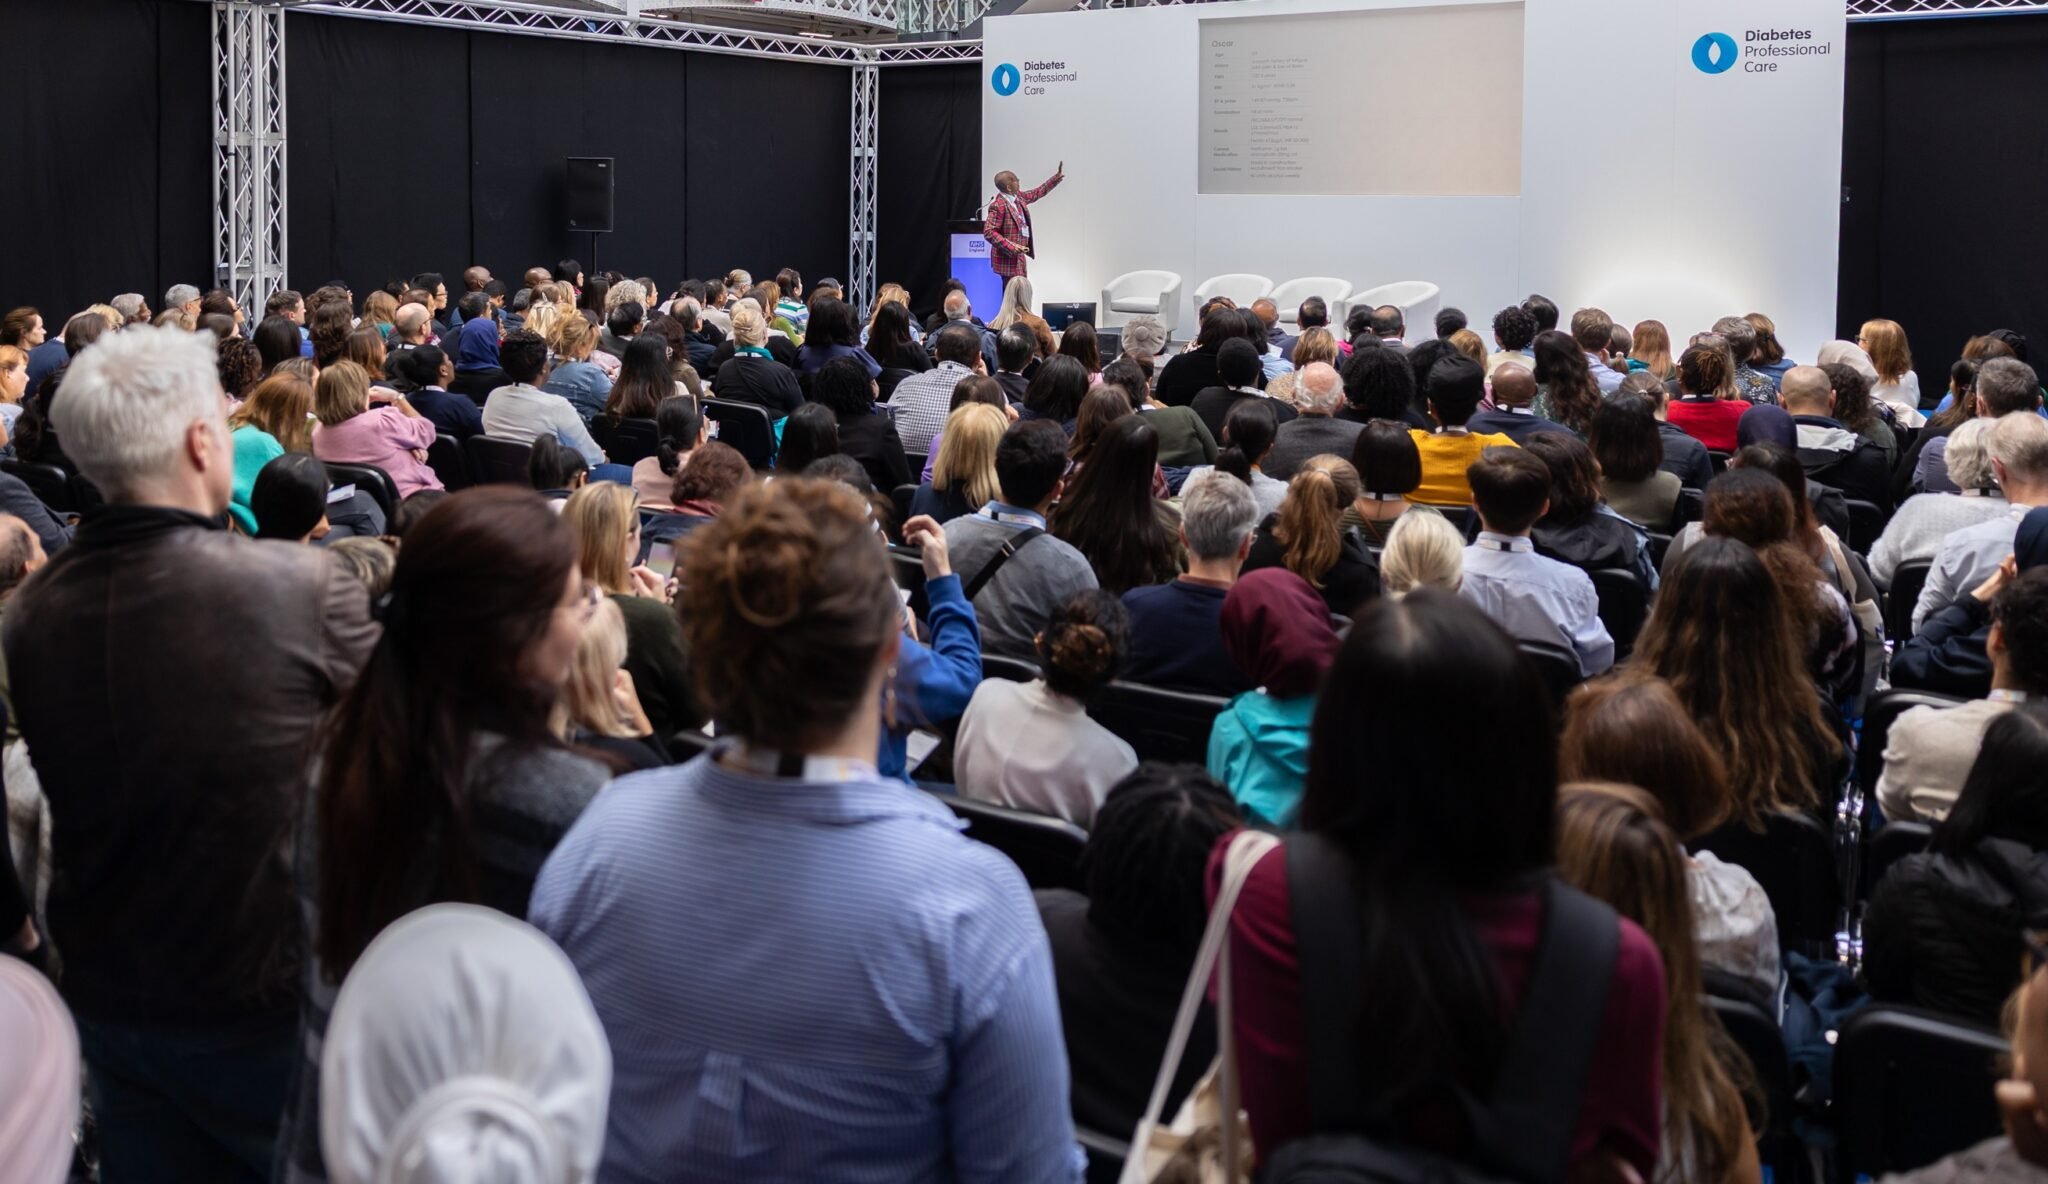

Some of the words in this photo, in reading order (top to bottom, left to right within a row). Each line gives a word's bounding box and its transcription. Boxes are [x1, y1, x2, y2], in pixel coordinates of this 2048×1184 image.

[1744, 29, 1812, 41] Diabetes
[1211, 40, 1234, 48] Oscar
[1744, 42, 1831, 57] Professional
[1024, 61, 1065, 71] Diabetes
[1744, 61, 1778, 73] Care
[1024, 71, 1077, 83] Professional
[1024, 86, 1045, 95] Care
